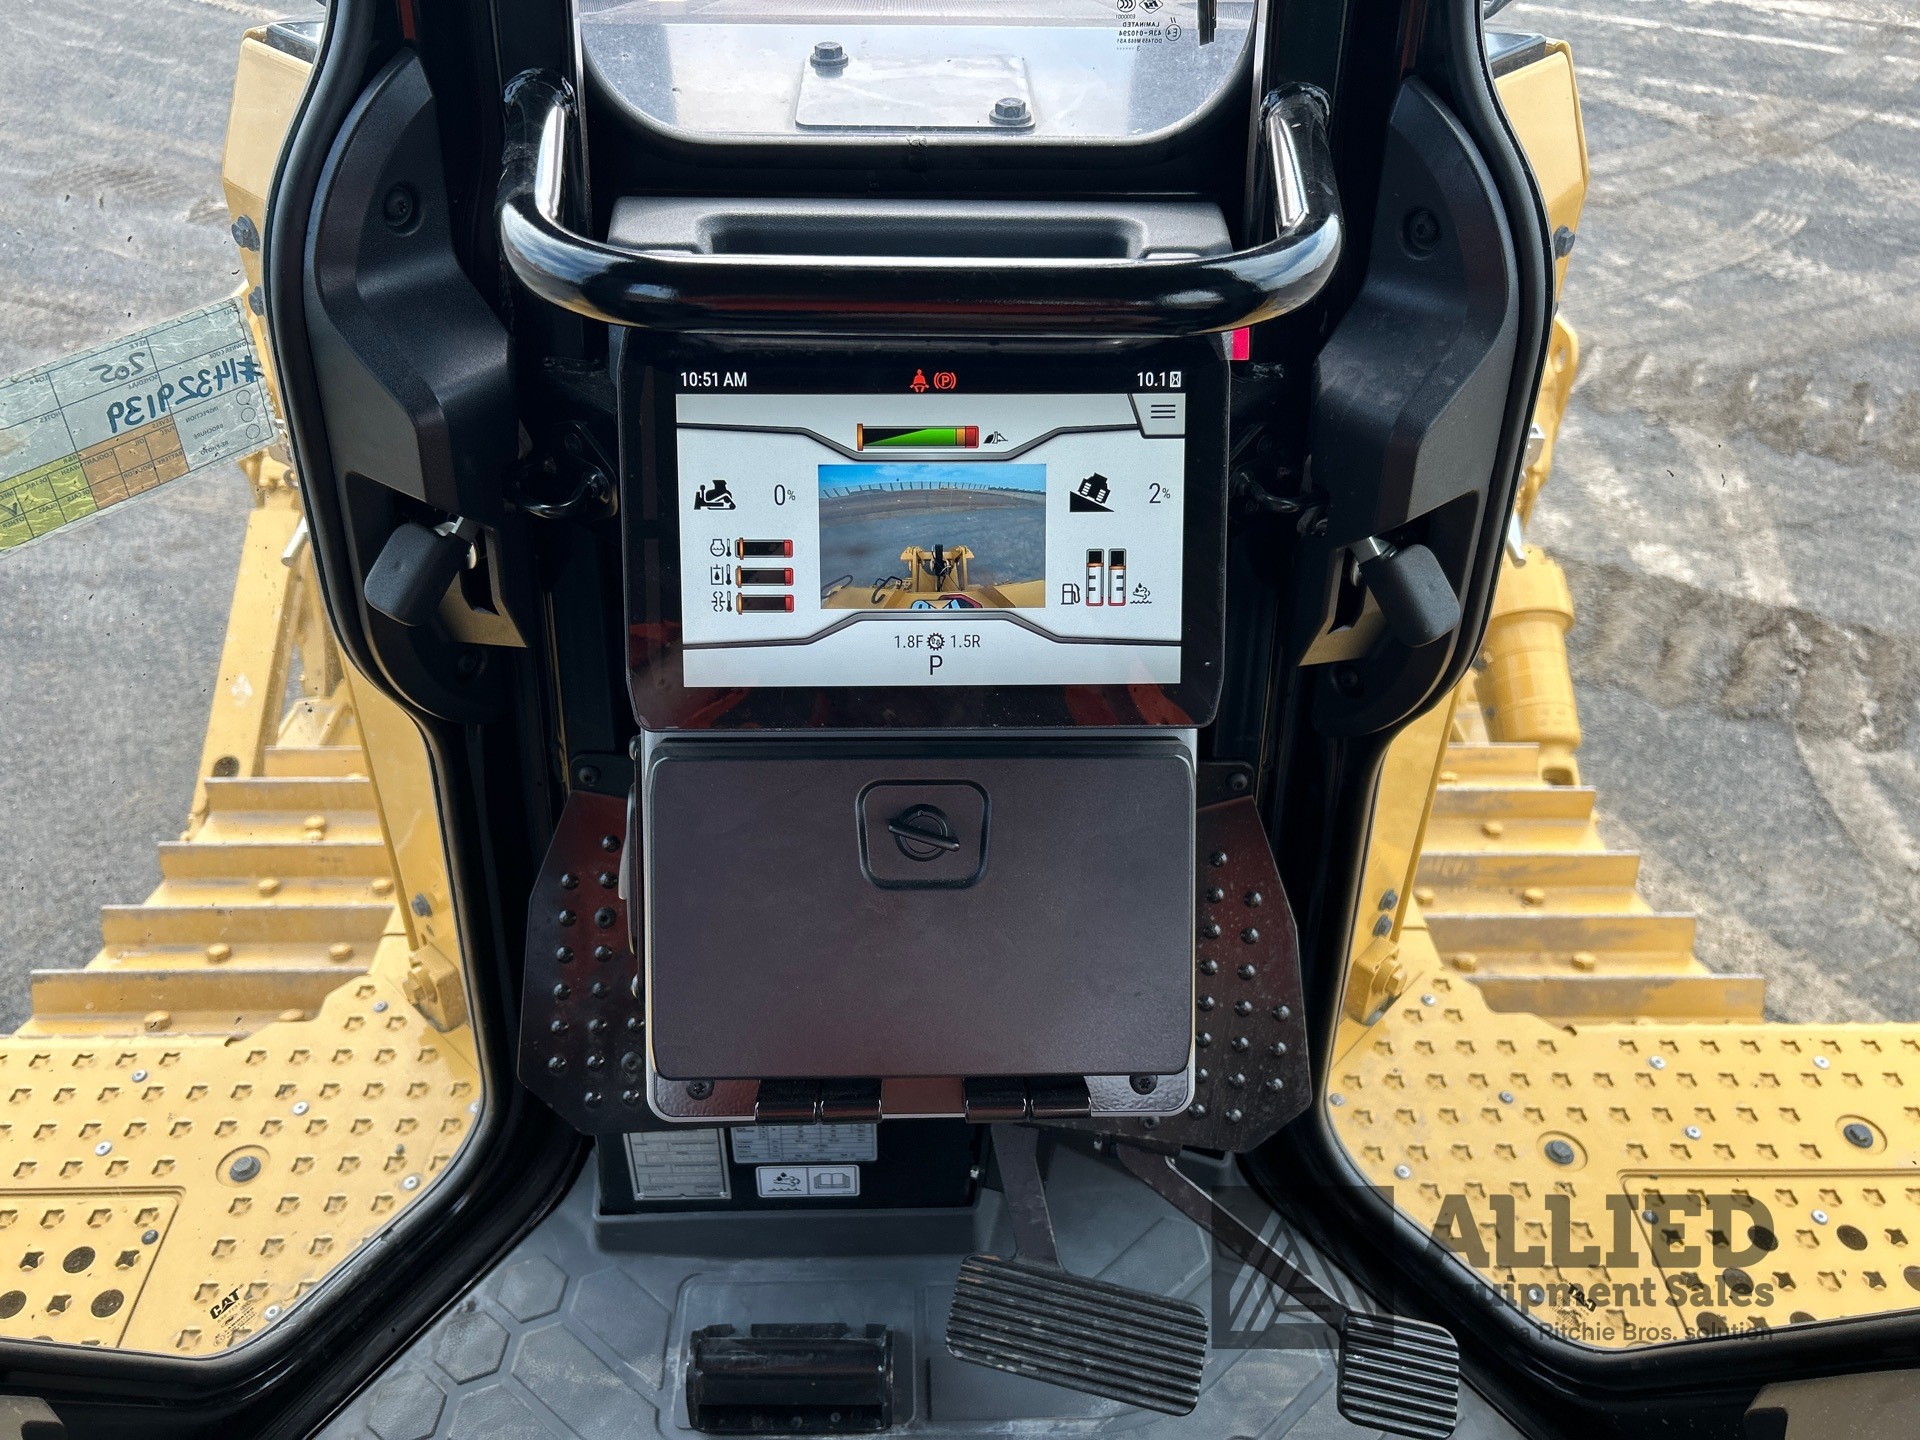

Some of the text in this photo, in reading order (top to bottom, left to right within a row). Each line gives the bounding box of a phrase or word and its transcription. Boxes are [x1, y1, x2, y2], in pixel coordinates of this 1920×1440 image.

[680, 371, 748, 387] 10:51 AM
[1136, 371, 1166, 388] 10.1
[894, 634, 981, 649] 1.8F 1.5R
[929, 655, 944, 676] P
[210, 1288, 239, 1320] CAT
